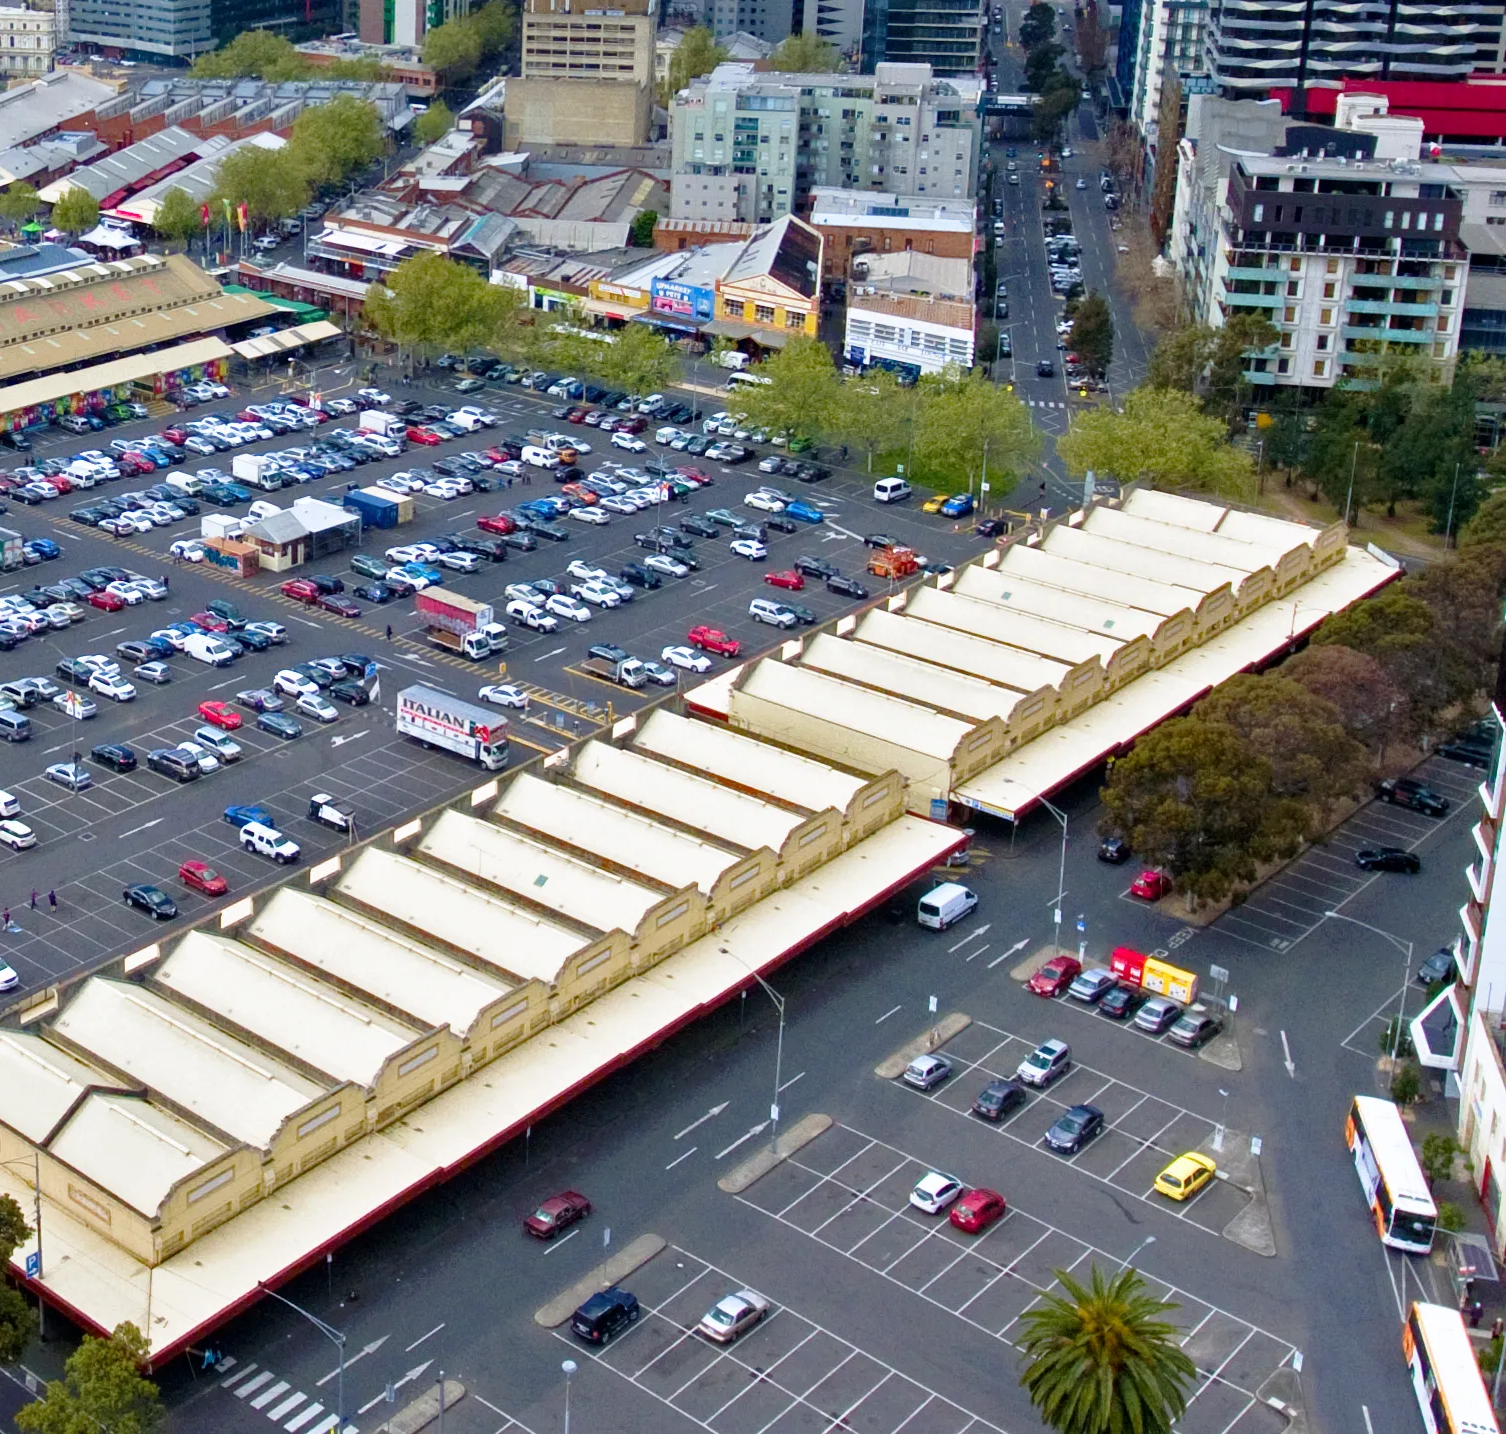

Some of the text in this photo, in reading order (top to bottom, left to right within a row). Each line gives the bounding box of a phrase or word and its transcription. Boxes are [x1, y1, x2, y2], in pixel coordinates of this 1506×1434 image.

[656, 282, 691, 295] UPMARKET
[403, 698, 464, 730] ITALIAN
[28, 1255, 37, 1269] P
